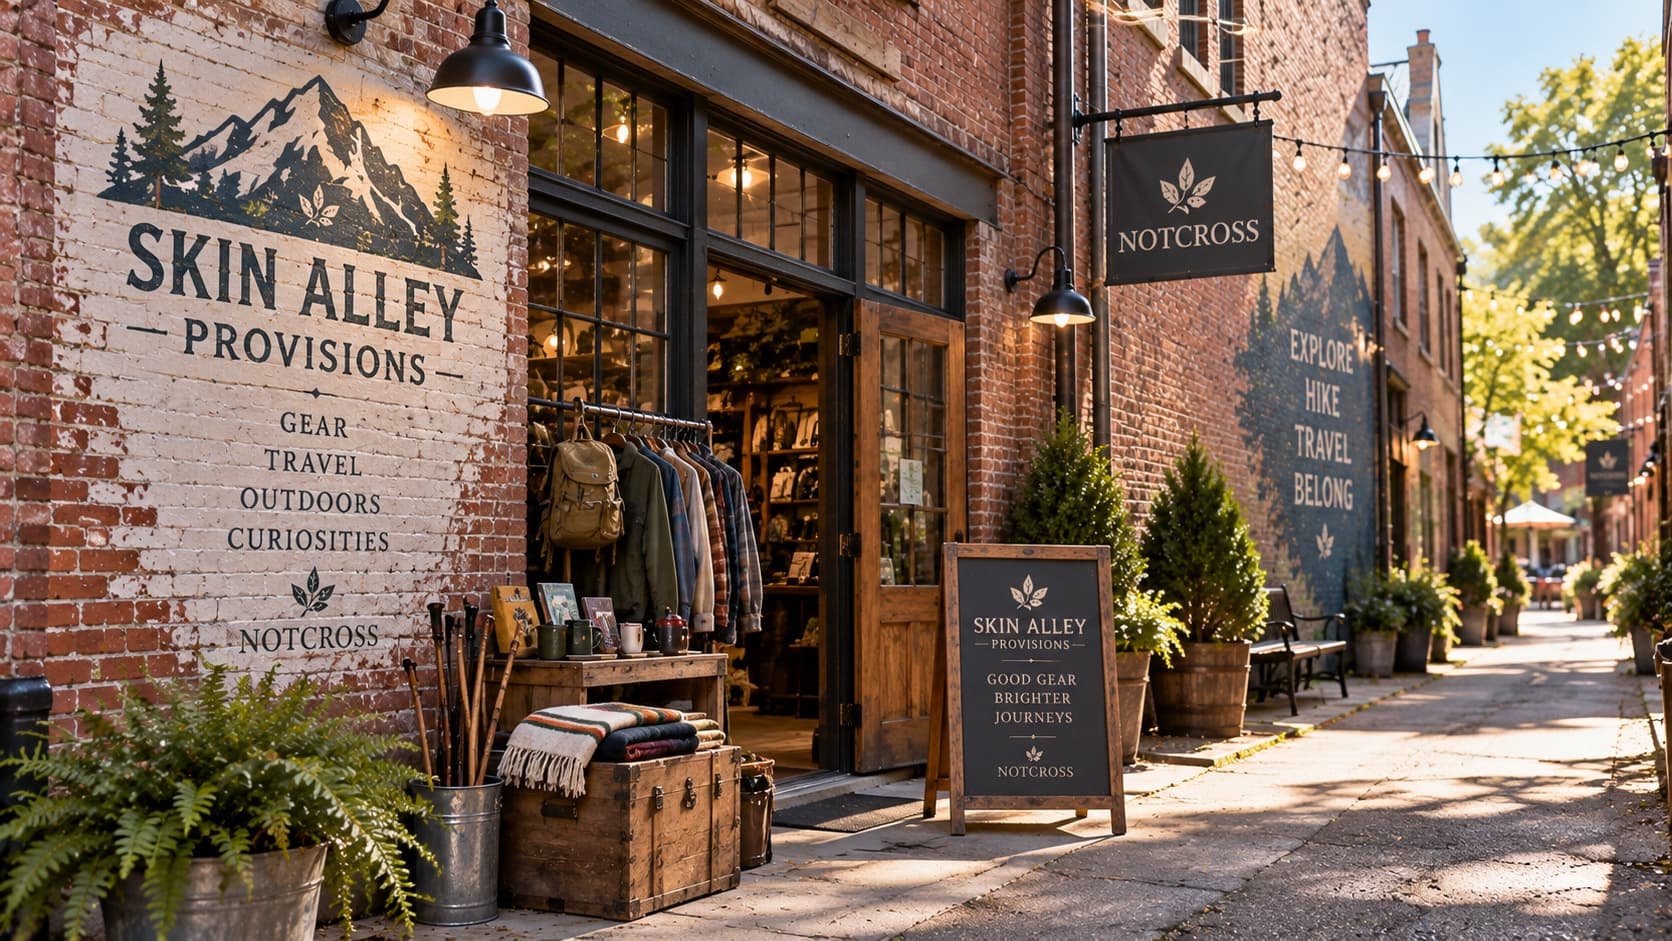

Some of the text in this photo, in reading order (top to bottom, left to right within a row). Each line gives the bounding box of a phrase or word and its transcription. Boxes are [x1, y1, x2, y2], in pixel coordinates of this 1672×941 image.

[1117, 218, 1260, 254] NOTCROSS
[126, 222, 465, 344] SKIN ALLEY
[183, 317, 427, 386] PROVISIONS
[1290, 327, 1354, 374] EXPLORE
[1305, 377, 1340, 418] HIKE
[280, 411, 349, 439] GEAR
[1294, 425, 1352, 465] TRAVEL
[264, 448, 362, 477] TRAVEL
[240, 486, 381, 515] OUTDOORS
[1294, 471, 1353, 511] BELONG
[227, 526, 390, 553] CURIOSITIES
[239, 623, 379, 655] NOTCROSS
[973, 617, 1087, 635] SKIN ALLEY
[991, 639, 1070, 650] PROVISIONS
[987, 673, 1077, 686] GOOD GEAR
[994, 692, 1071, 704] BRIGHTER
[994, 711, 1073, 725] JOURNEYS
[997, 766, 1074, 778] NOTCROSS
